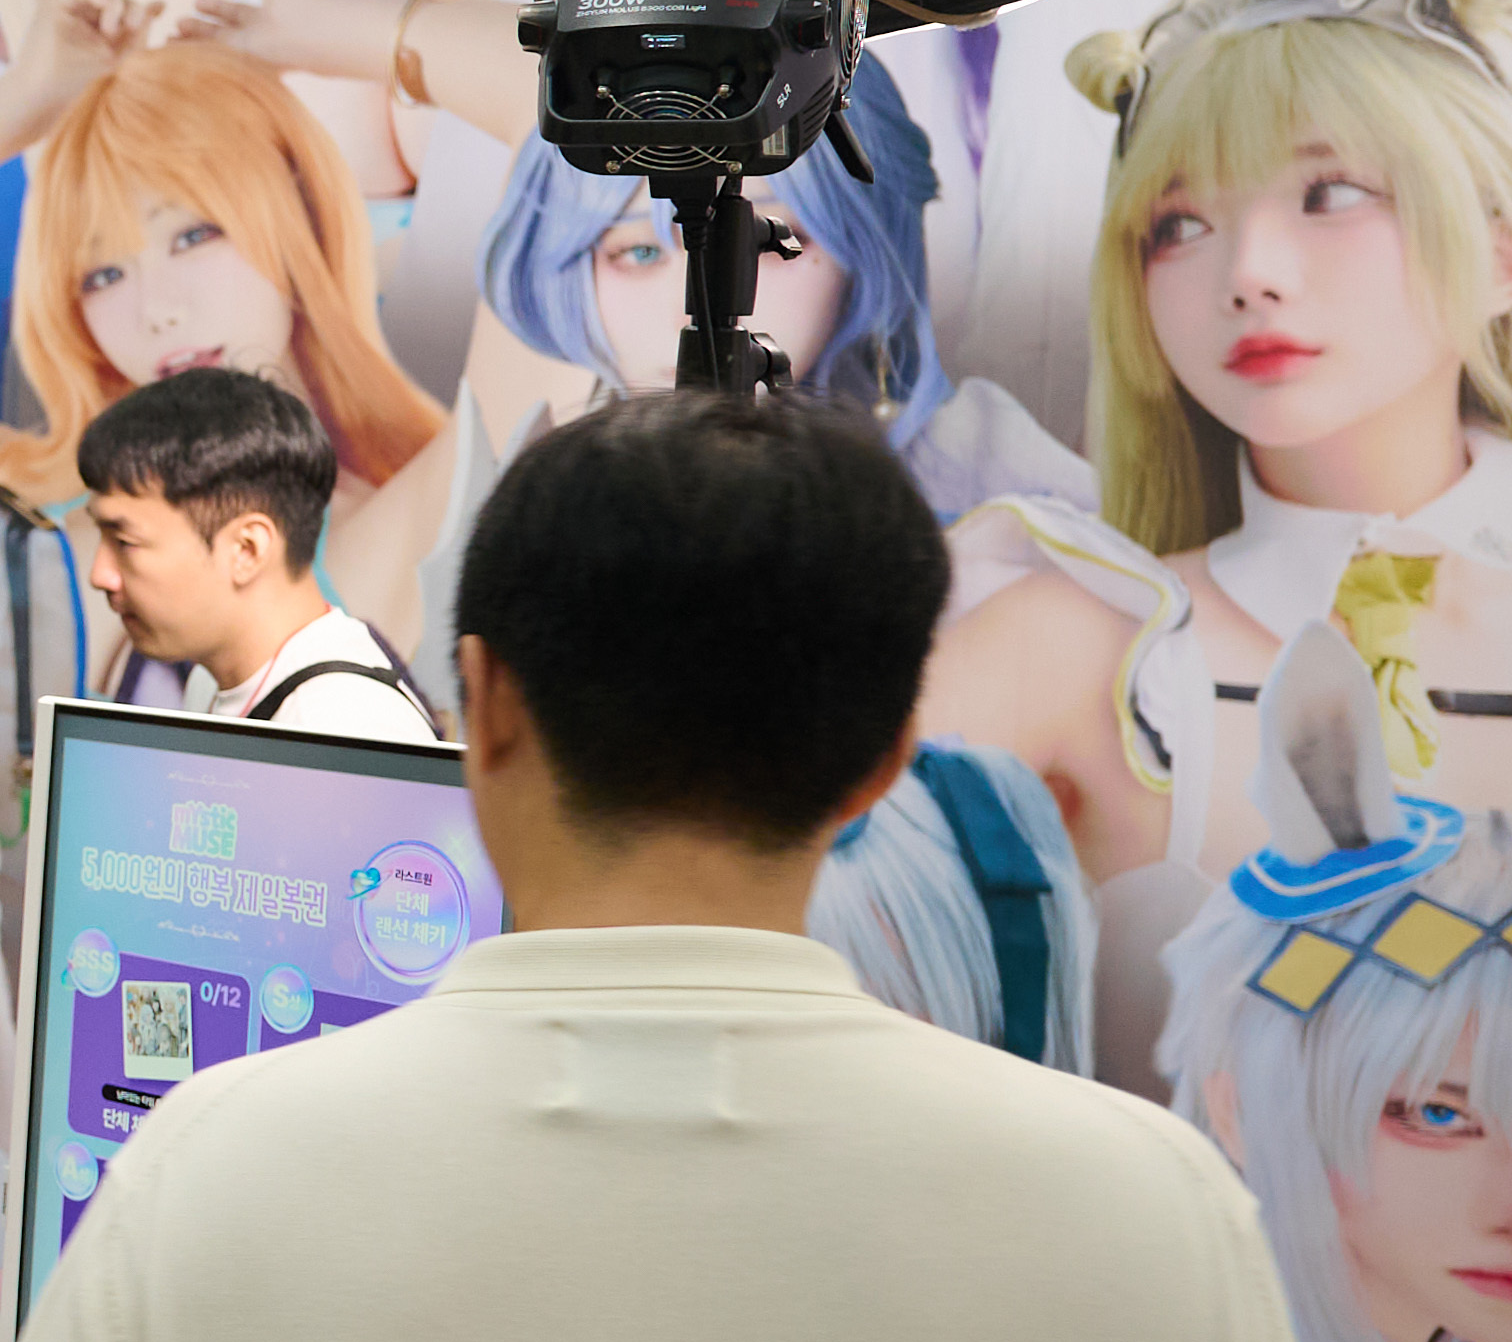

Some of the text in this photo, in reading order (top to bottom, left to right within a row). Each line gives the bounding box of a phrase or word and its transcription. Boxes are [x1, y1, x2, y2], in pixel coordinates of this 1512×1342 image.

[169, 826, 237, 861] MUSE
[81, 846, 185, 904] 5,000원의
[187, 861, 233, 911] 행복
[395, 891, 430, 917] 단체
[375, 916, 447, 949] 랜선 체키
[200, 981, 242, 1008] 0/12
[103, 1108, 130, 1133] 단체
